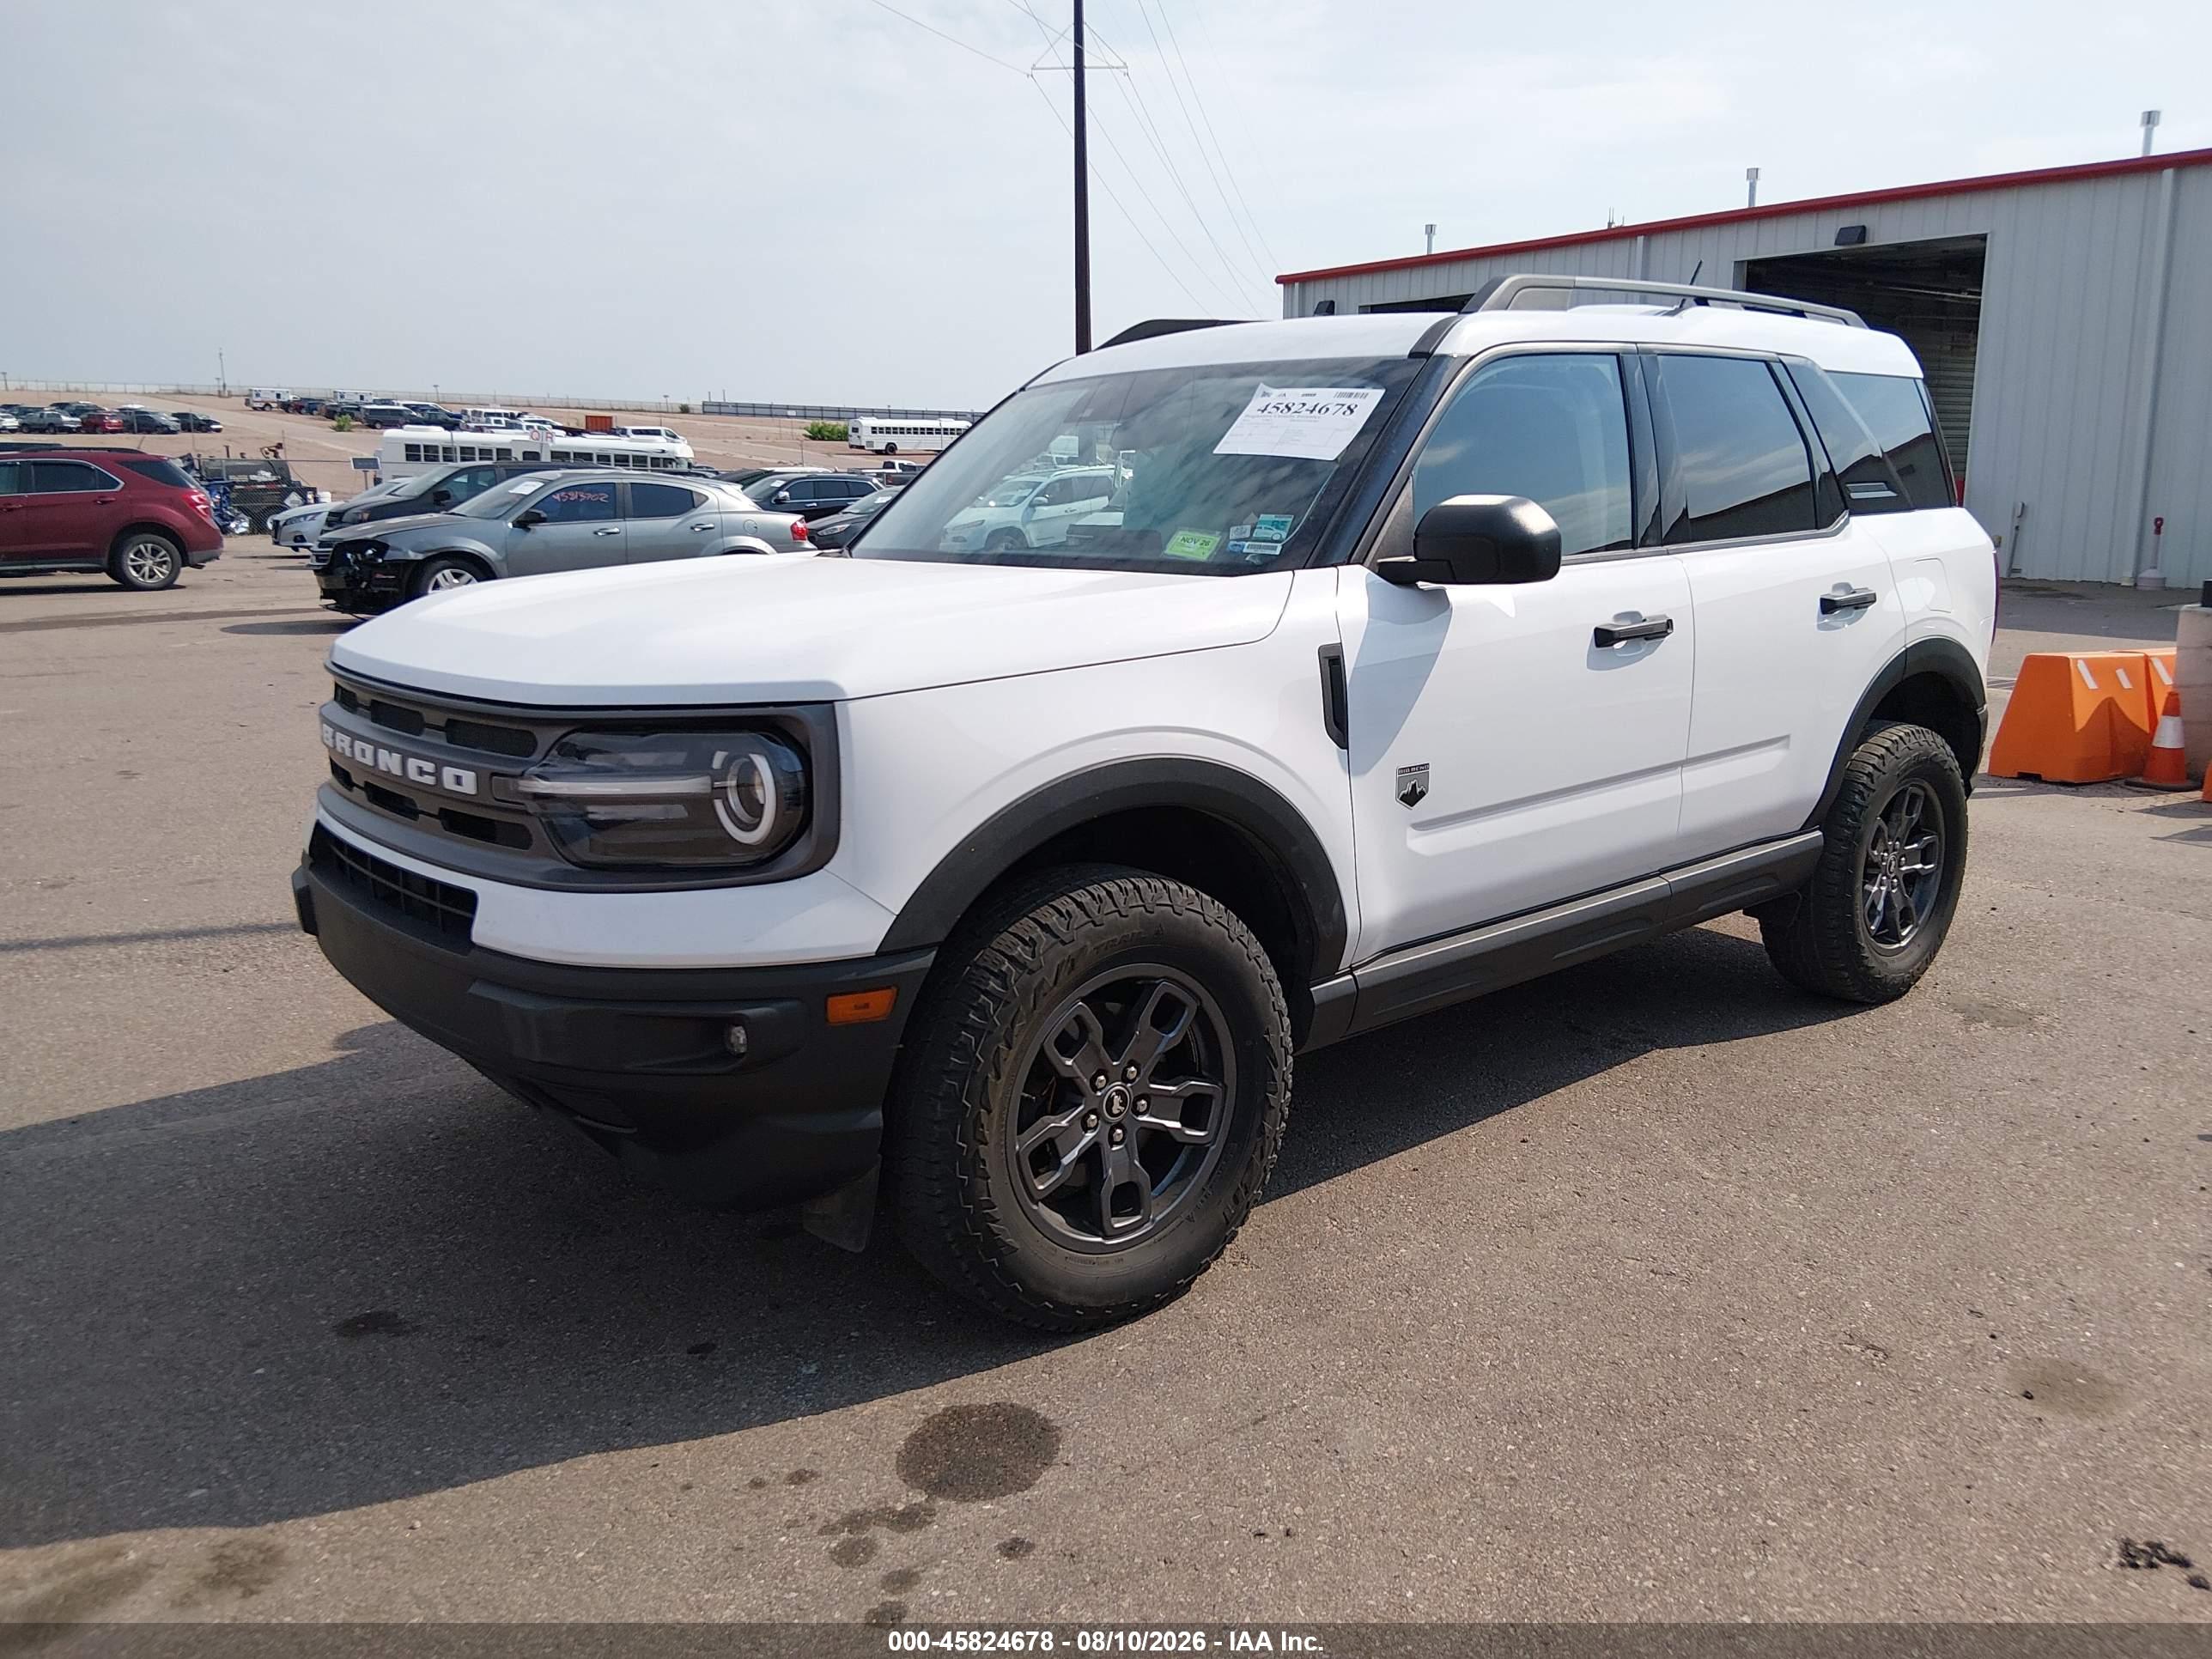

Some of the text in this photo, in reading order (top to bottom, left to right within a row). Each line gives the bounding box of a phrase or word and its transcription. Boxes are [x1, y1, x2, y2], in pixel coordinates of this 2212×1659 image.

[1257, 402, 1358, 416] 45824678
[1180, 536, 1200, 544] NOV
[322, 723, 477, 795] BRONCO
